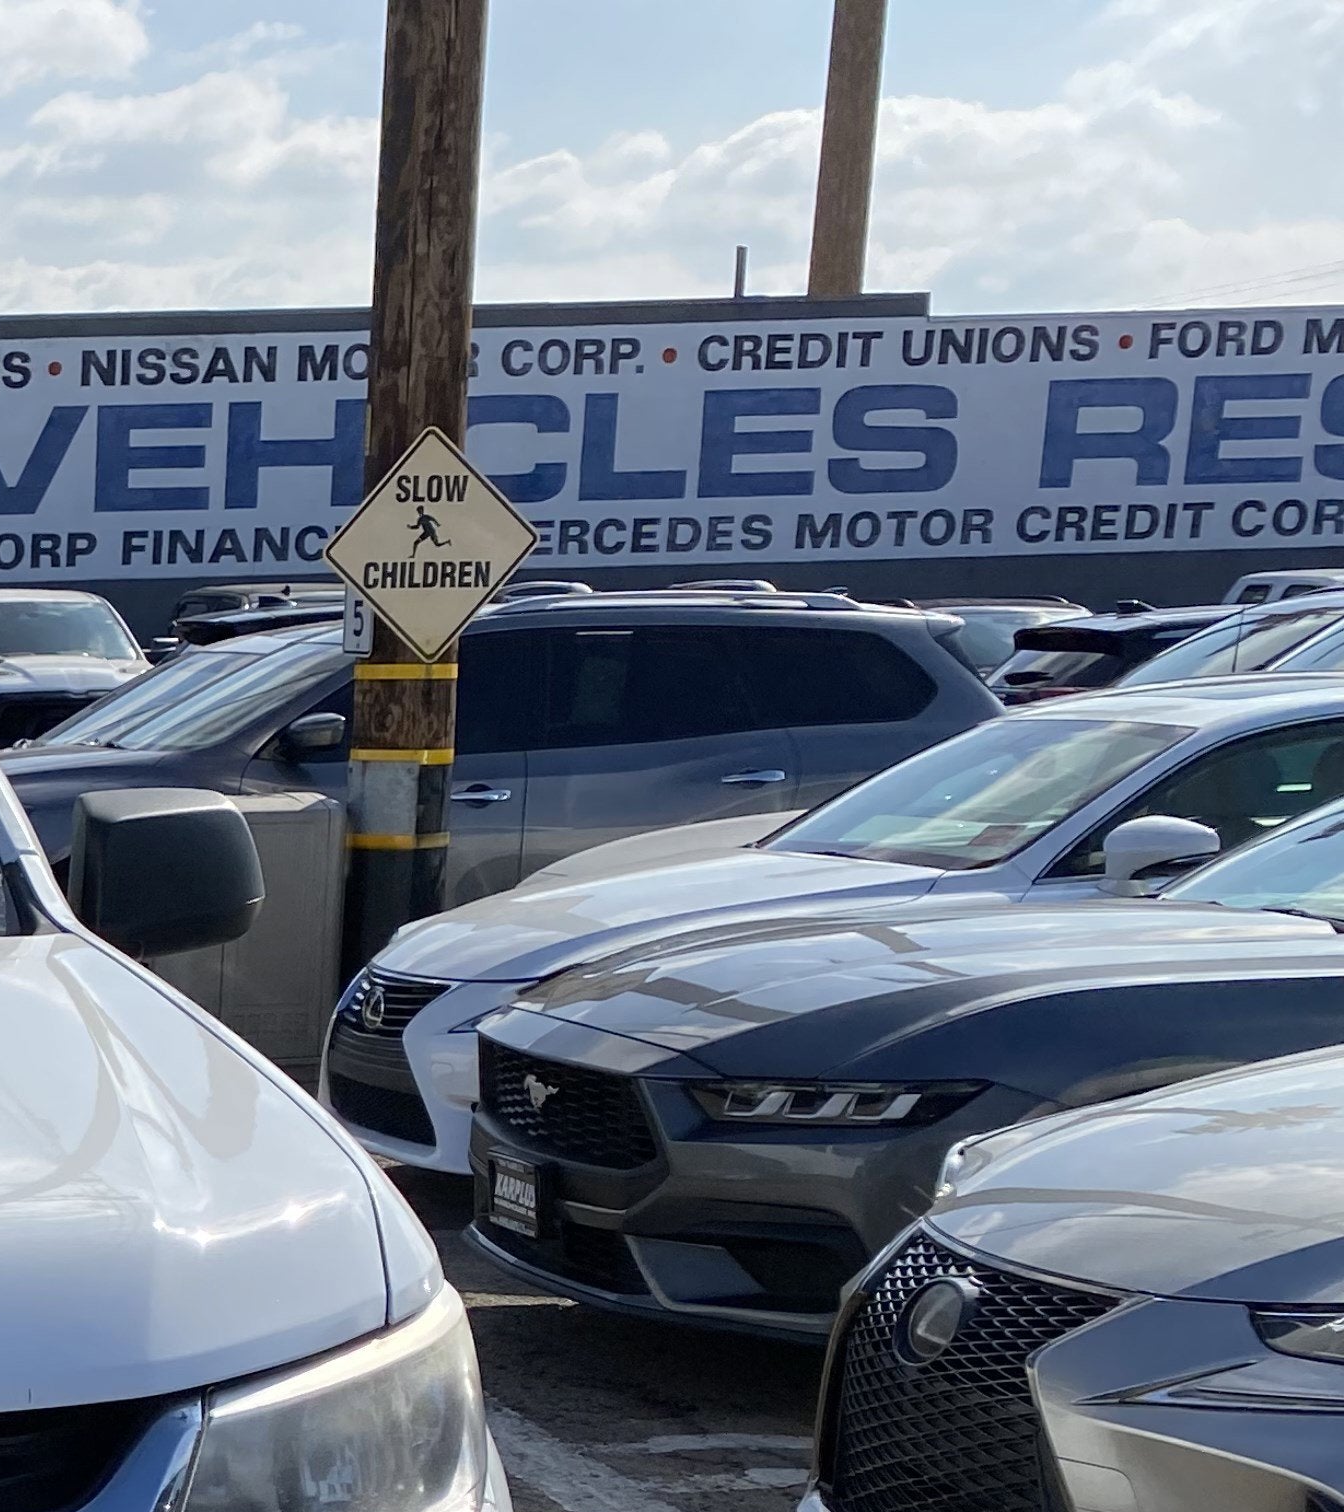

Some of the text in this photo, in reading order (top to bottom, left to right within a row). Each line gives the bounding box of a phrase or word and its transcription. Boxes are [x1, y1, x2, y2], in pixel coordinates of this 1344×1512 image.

[80, 345, 278, 387] NISSAN
[500, 338, 644, 377] CORP.
[697, 331, 885, 372] CREDIT
[901, 324, 1101, 367] UNIONS
[1148, 319, 1285, 360] FORD
[395, 474, 469, 503] SLOW
[121, 525, 343, 566] FINANC
[528, 513, 775, 556] ERCEDES
[795, 508, 994, 550] MOTOR
[1016, 502, 1215, 544] CREDIT
[363, 560, 491, 589] CHILDREN
